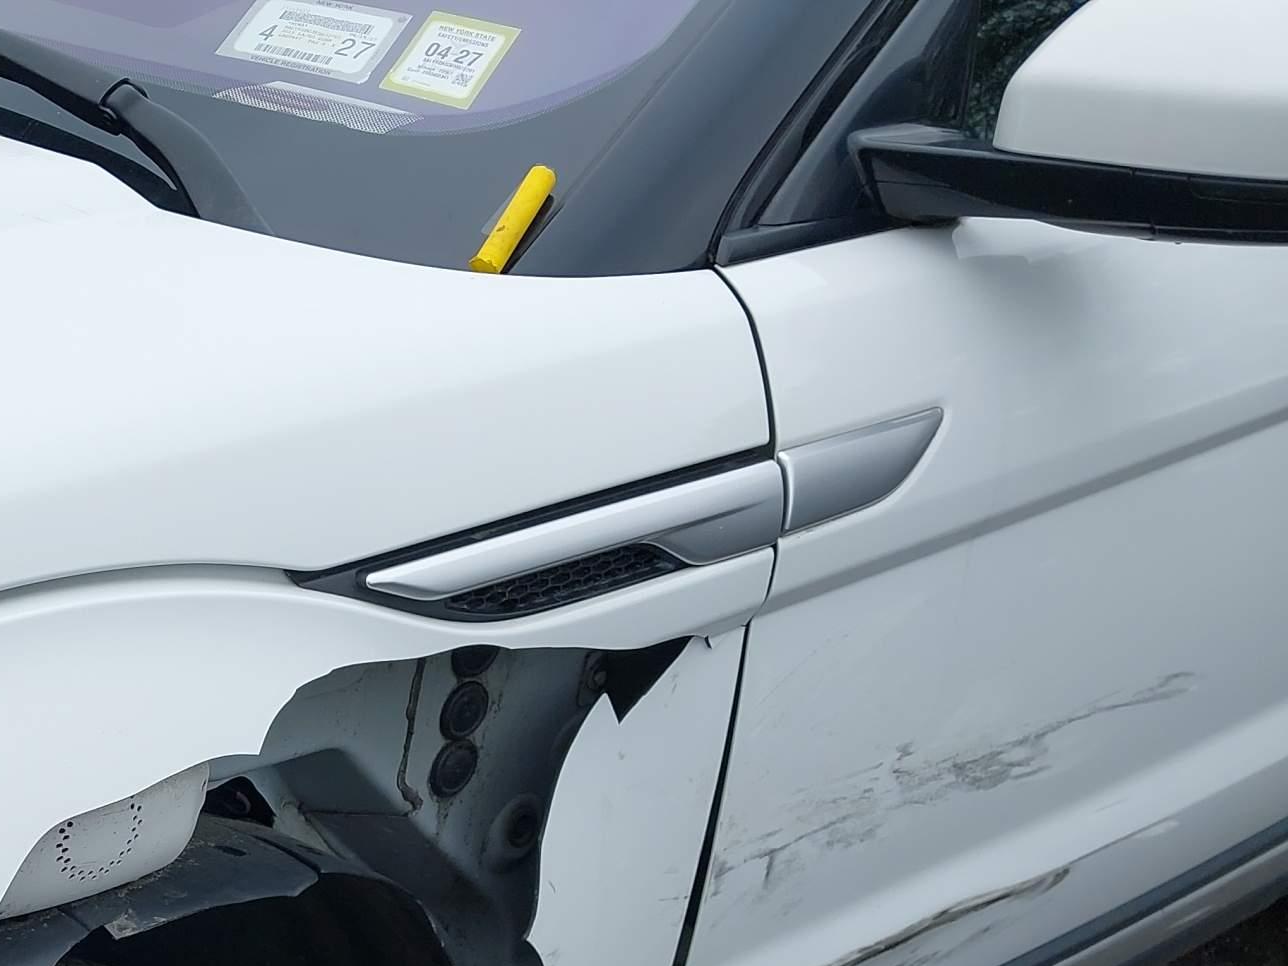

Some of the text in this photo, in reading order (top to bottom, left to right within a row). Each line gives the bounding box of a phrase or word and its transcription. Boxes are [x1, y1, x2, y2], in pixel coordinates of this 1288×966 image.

[258, 24, 278, 41] 4
[439, 25, 496, 42] NEW YORK STATE
[334, 38, 376, 59] 27
[425, 42, 452, 60] 04
[454, 49, 484, 66] 27
